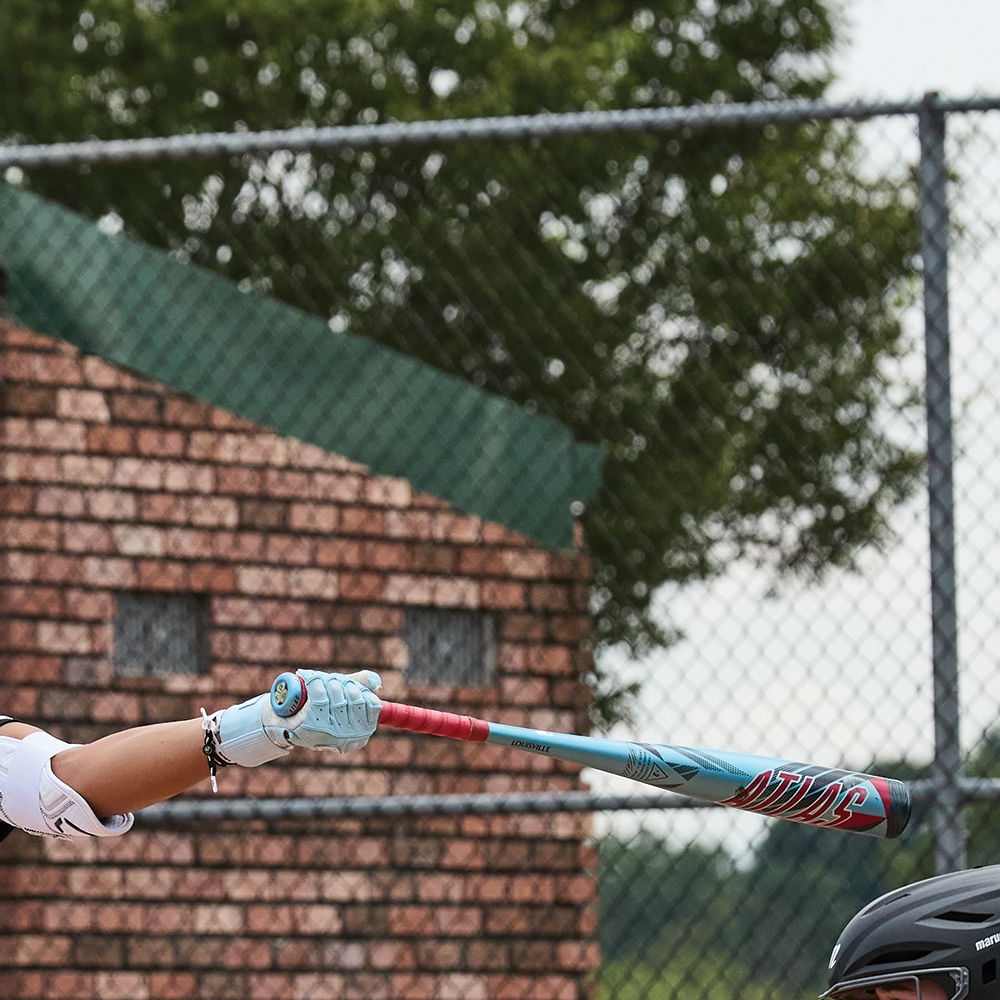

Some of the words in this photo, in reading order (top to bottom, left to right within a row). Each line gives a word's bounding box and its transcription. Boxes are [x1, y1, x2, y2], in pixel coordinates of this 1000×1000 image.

[511, 740, 552, 753] LOUISVILLE
[715, 769, 869, 829] ATLAS
[975, 932, 1000, 951] maru
